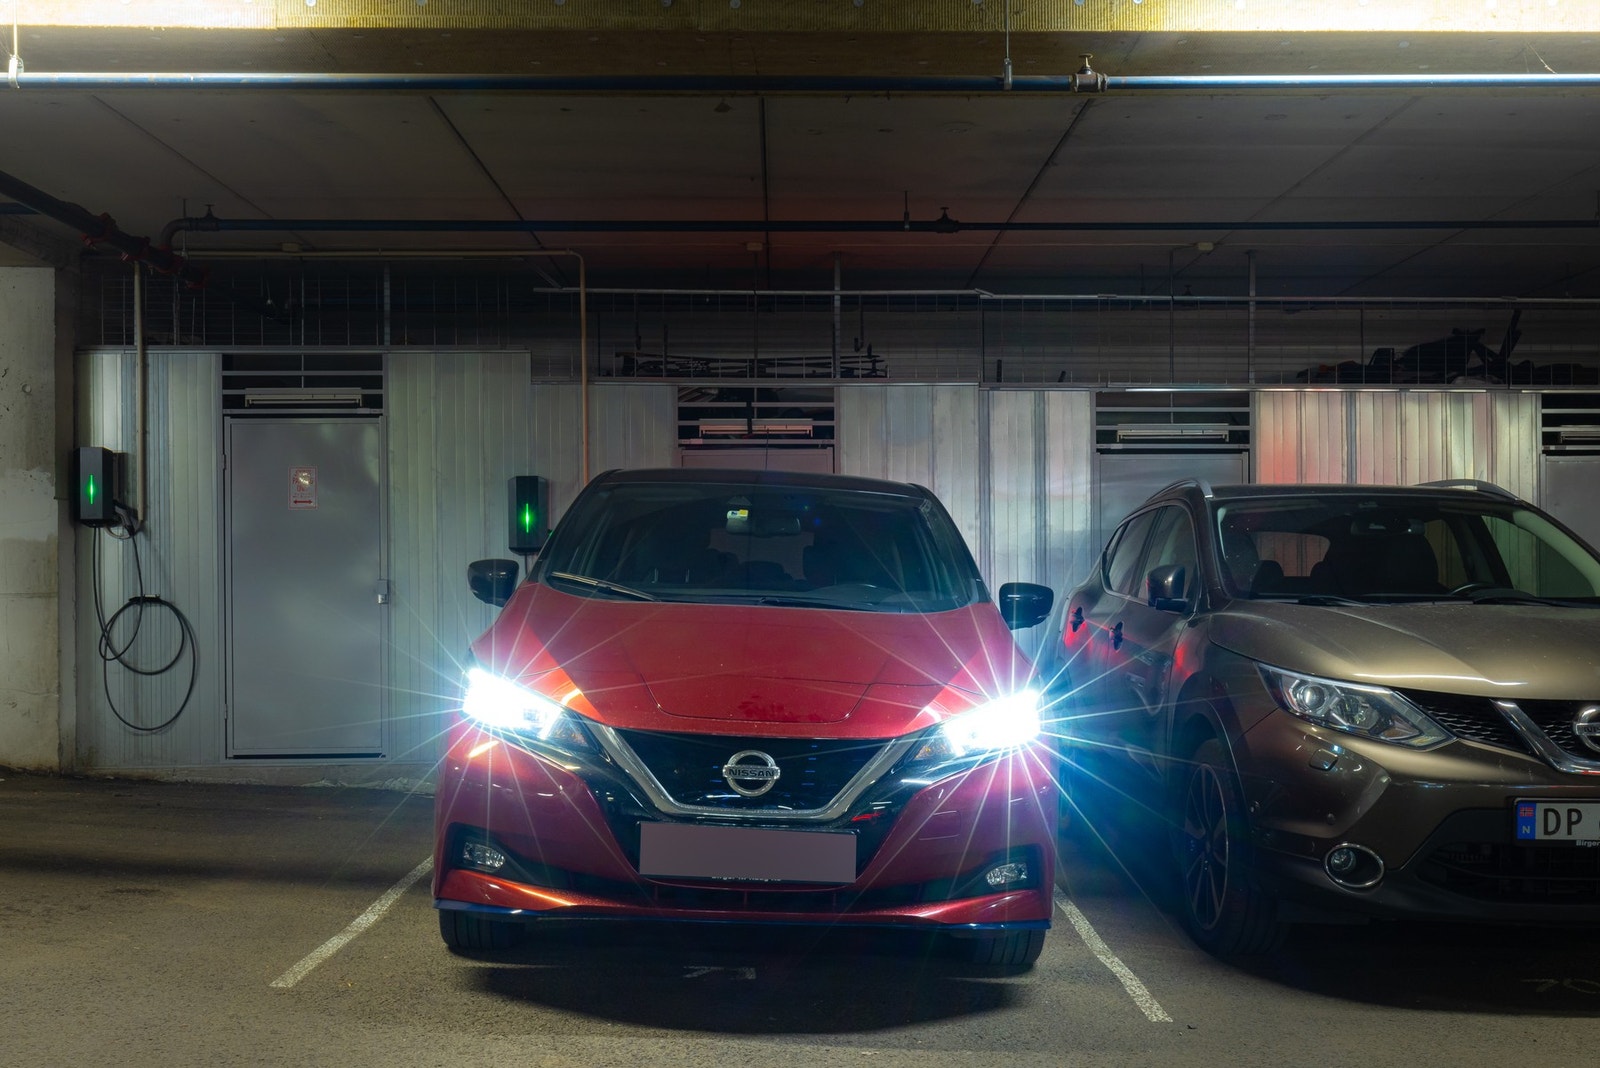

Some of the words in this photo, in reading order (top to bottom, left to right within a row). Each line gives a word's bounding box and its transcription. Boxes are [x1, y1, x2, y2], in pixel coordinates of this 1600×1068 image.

[729, 768, 774, 777] NISSAN
[1543, 807, 1583, 836] DP
[1522, 825, 1531, 834] N
